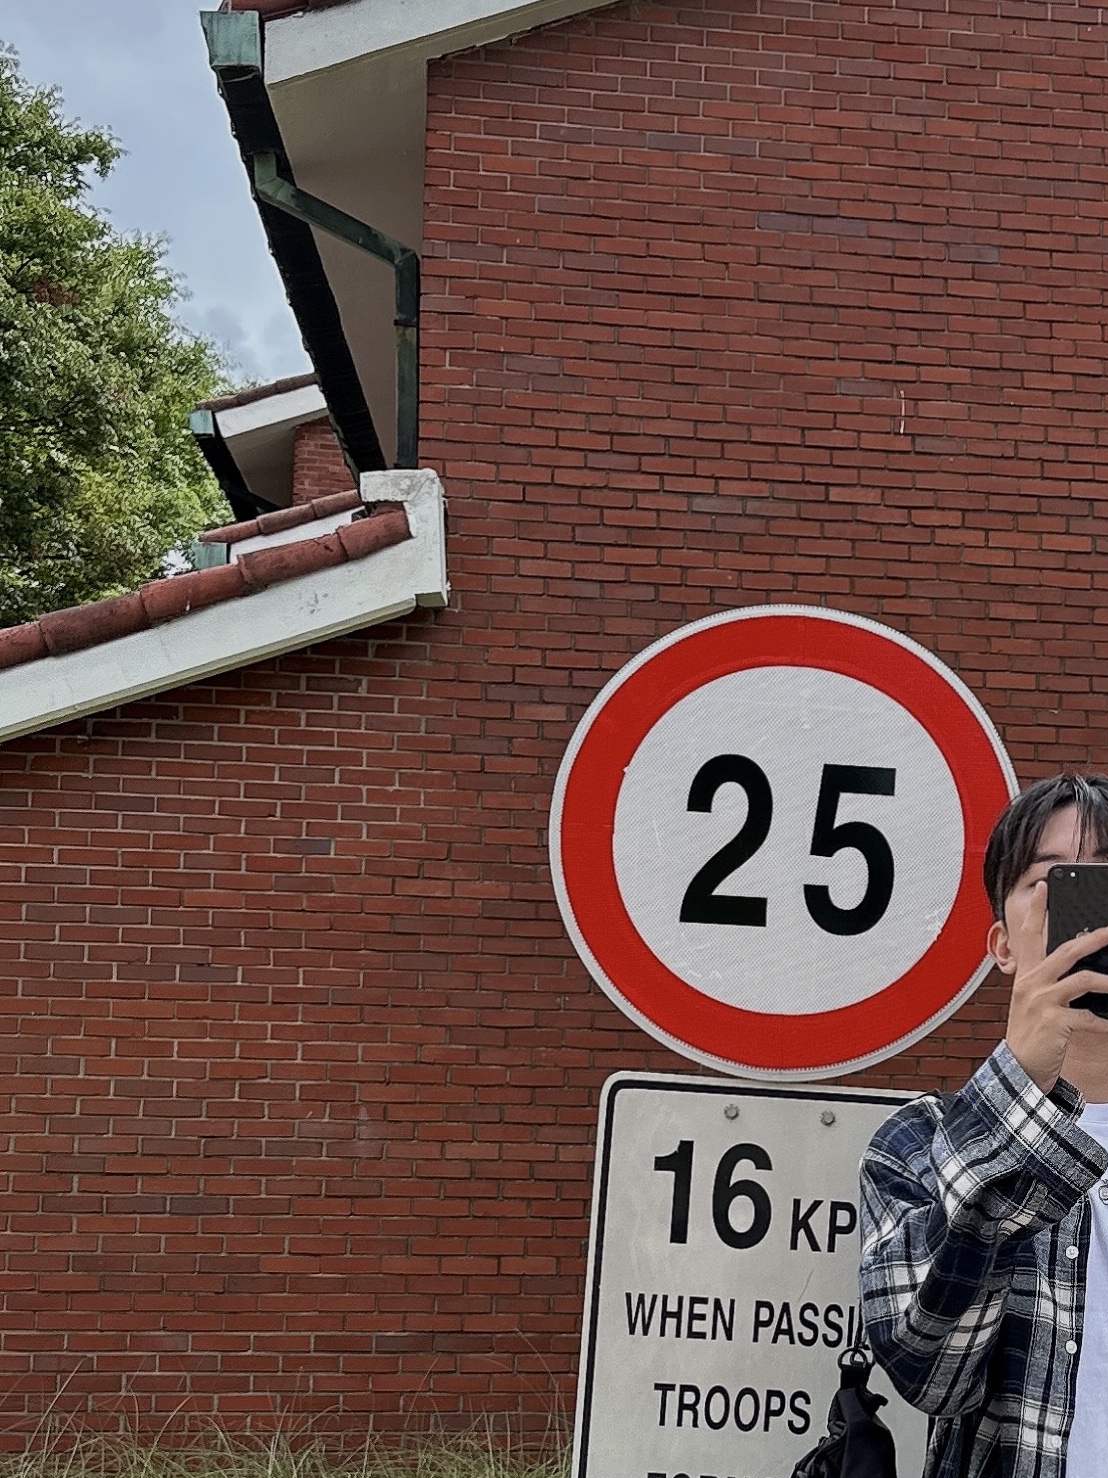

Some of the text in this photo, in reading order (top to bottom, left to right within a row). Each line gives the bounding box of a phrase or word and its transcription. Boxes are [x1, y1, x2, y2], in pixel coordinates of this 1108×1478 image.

[678, 753, 897, 937] 25
[653, 1139, 773, 1250] 16
[624, 1292, 871, 1350] WHEN PASSI
[653, 1382, 812, 1436] TROOPS
